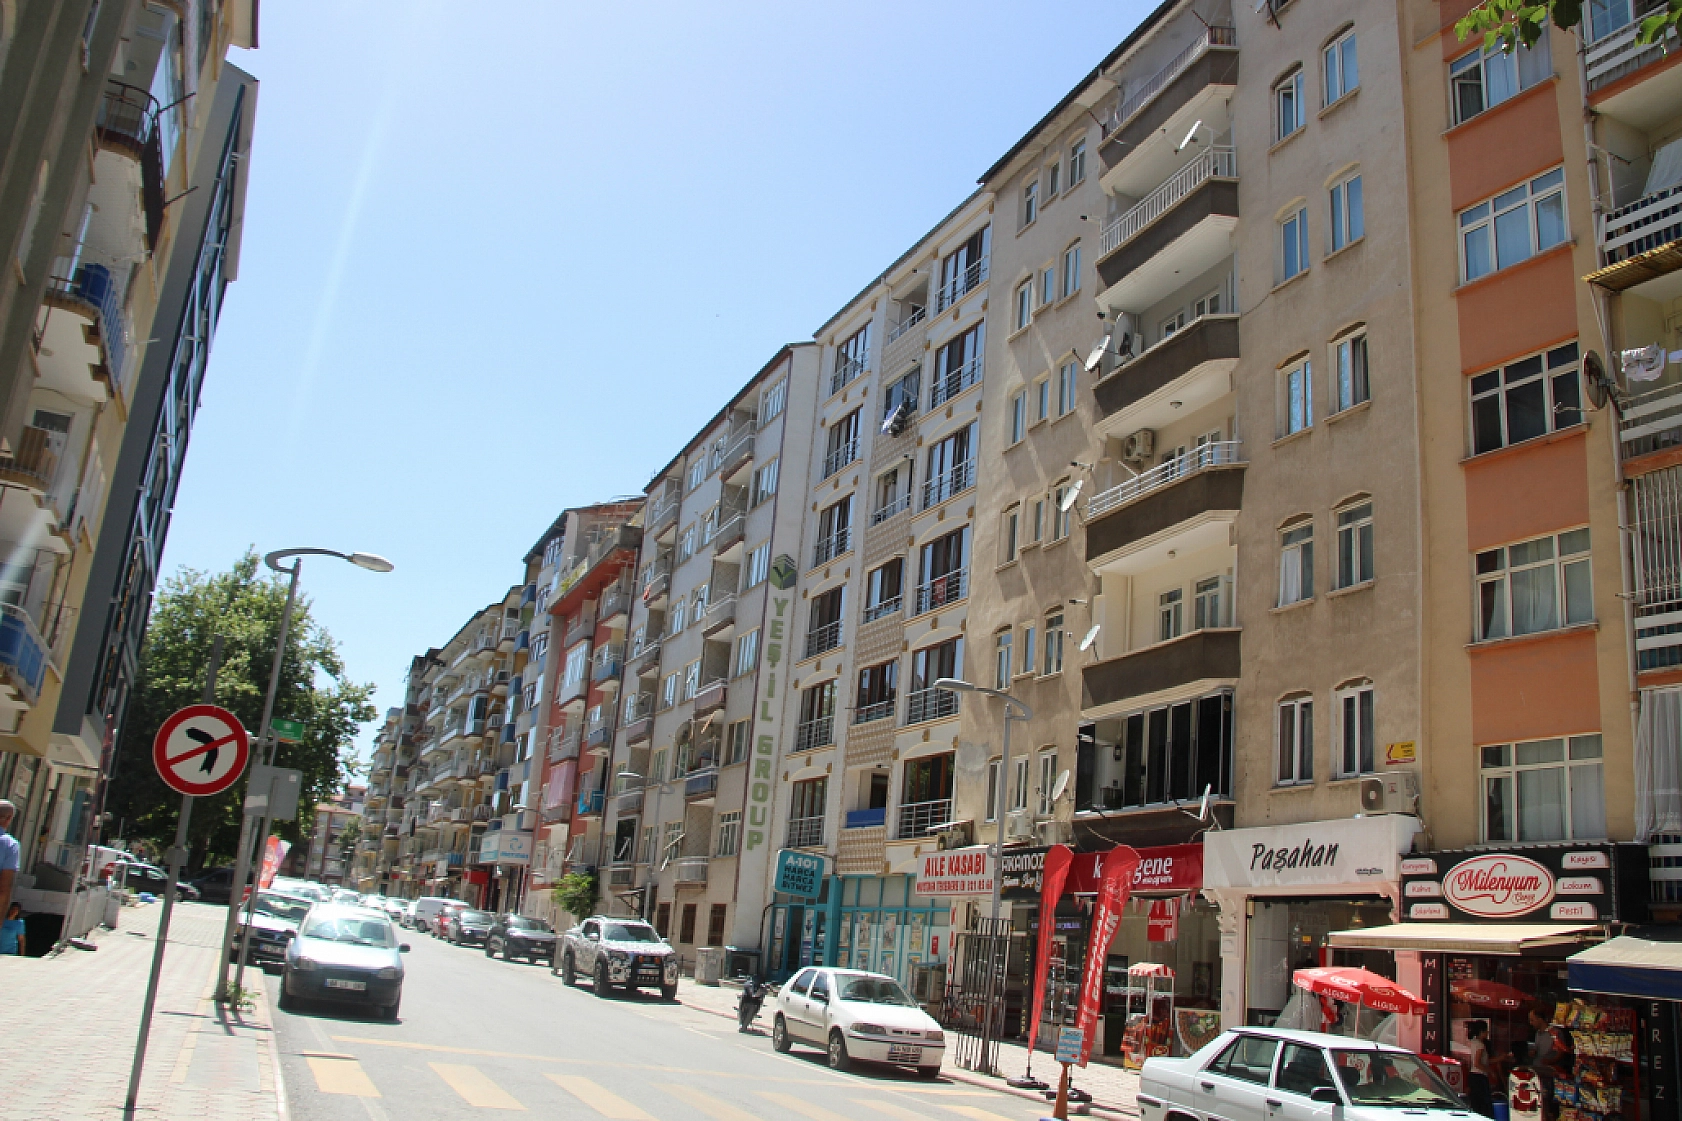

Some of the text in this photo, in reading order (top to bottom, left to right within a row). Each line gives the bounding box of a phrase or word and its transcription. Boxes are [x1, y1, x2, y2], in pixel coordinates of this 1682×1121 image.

[746, 734, 774, 851] GROUP
[1250, 838, 1339, 874] Paşahan
[1453, 864, 1541, 902] Milenyum
